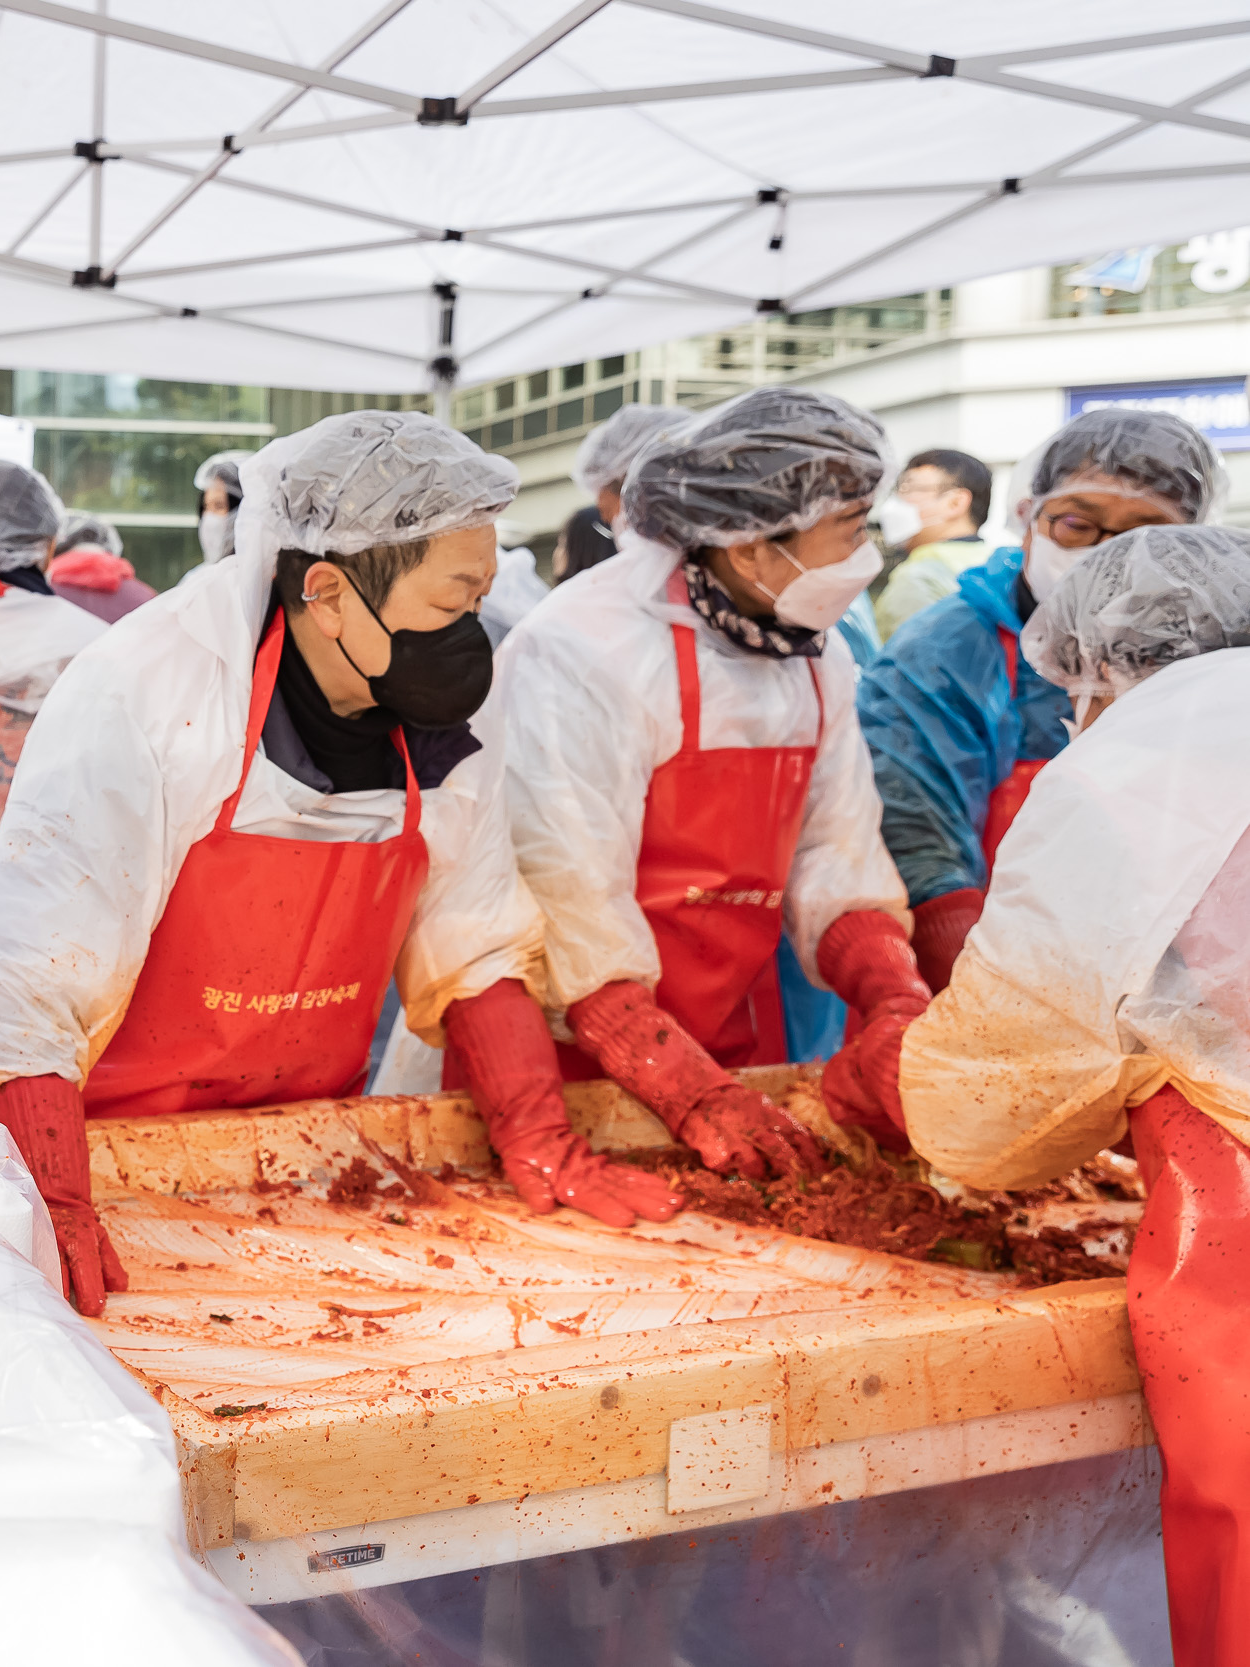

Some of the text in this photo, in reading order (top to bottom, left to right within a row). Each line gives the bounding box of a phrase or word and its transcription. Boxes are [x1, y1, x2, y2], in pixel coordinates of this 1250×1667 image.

[201, 981, 361, 1015] 광진 사랑의 김장축제
